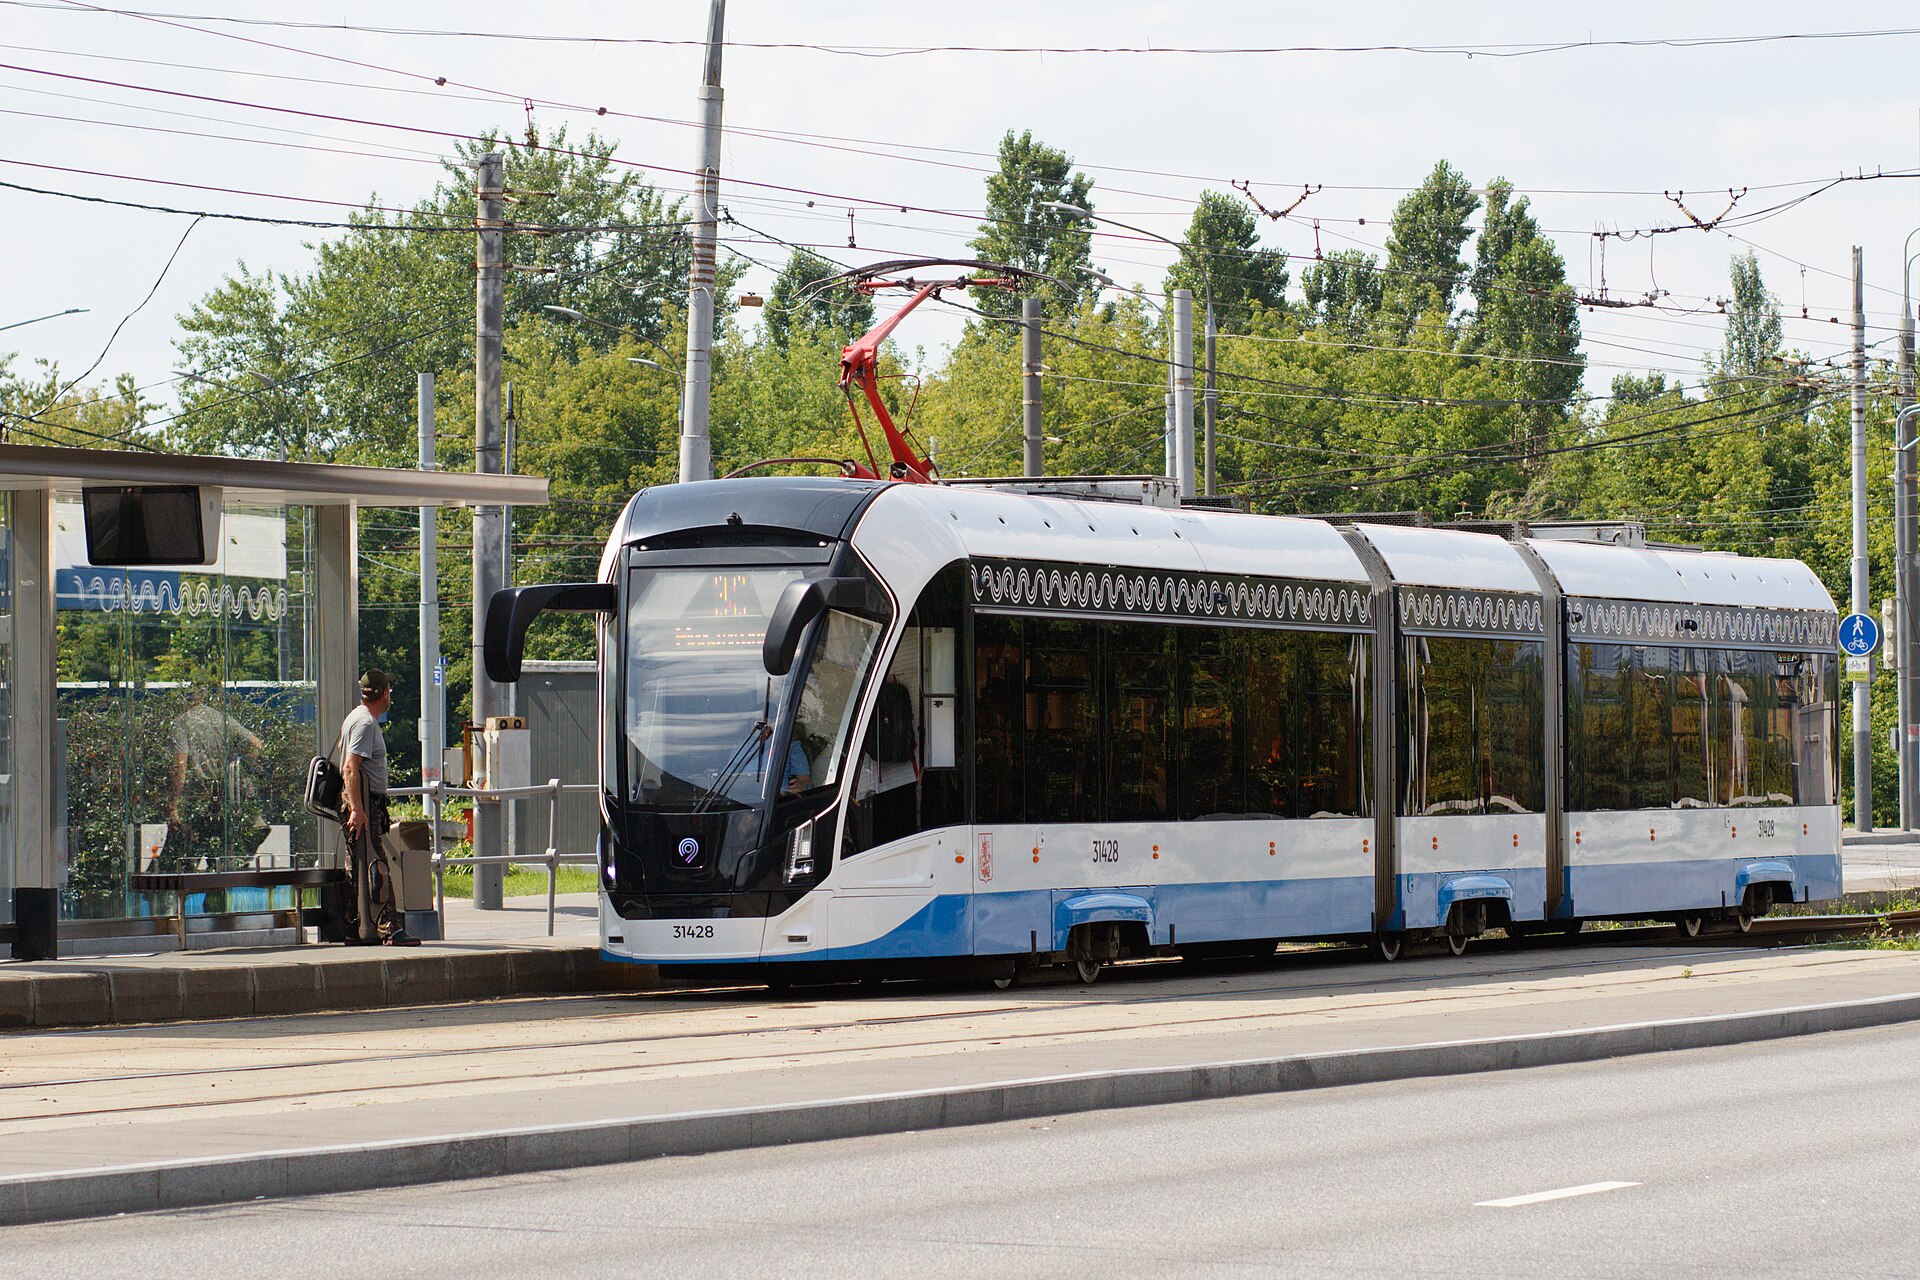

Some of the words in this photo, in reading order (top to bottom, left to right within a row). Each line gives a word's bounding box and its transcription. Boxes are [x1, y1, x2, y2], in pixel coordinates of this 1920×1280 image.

[1758, 819, 1775, 837] 31428
[1092, 839, 1119, 863] 31428
[673, 925, 714, 938] 31428
